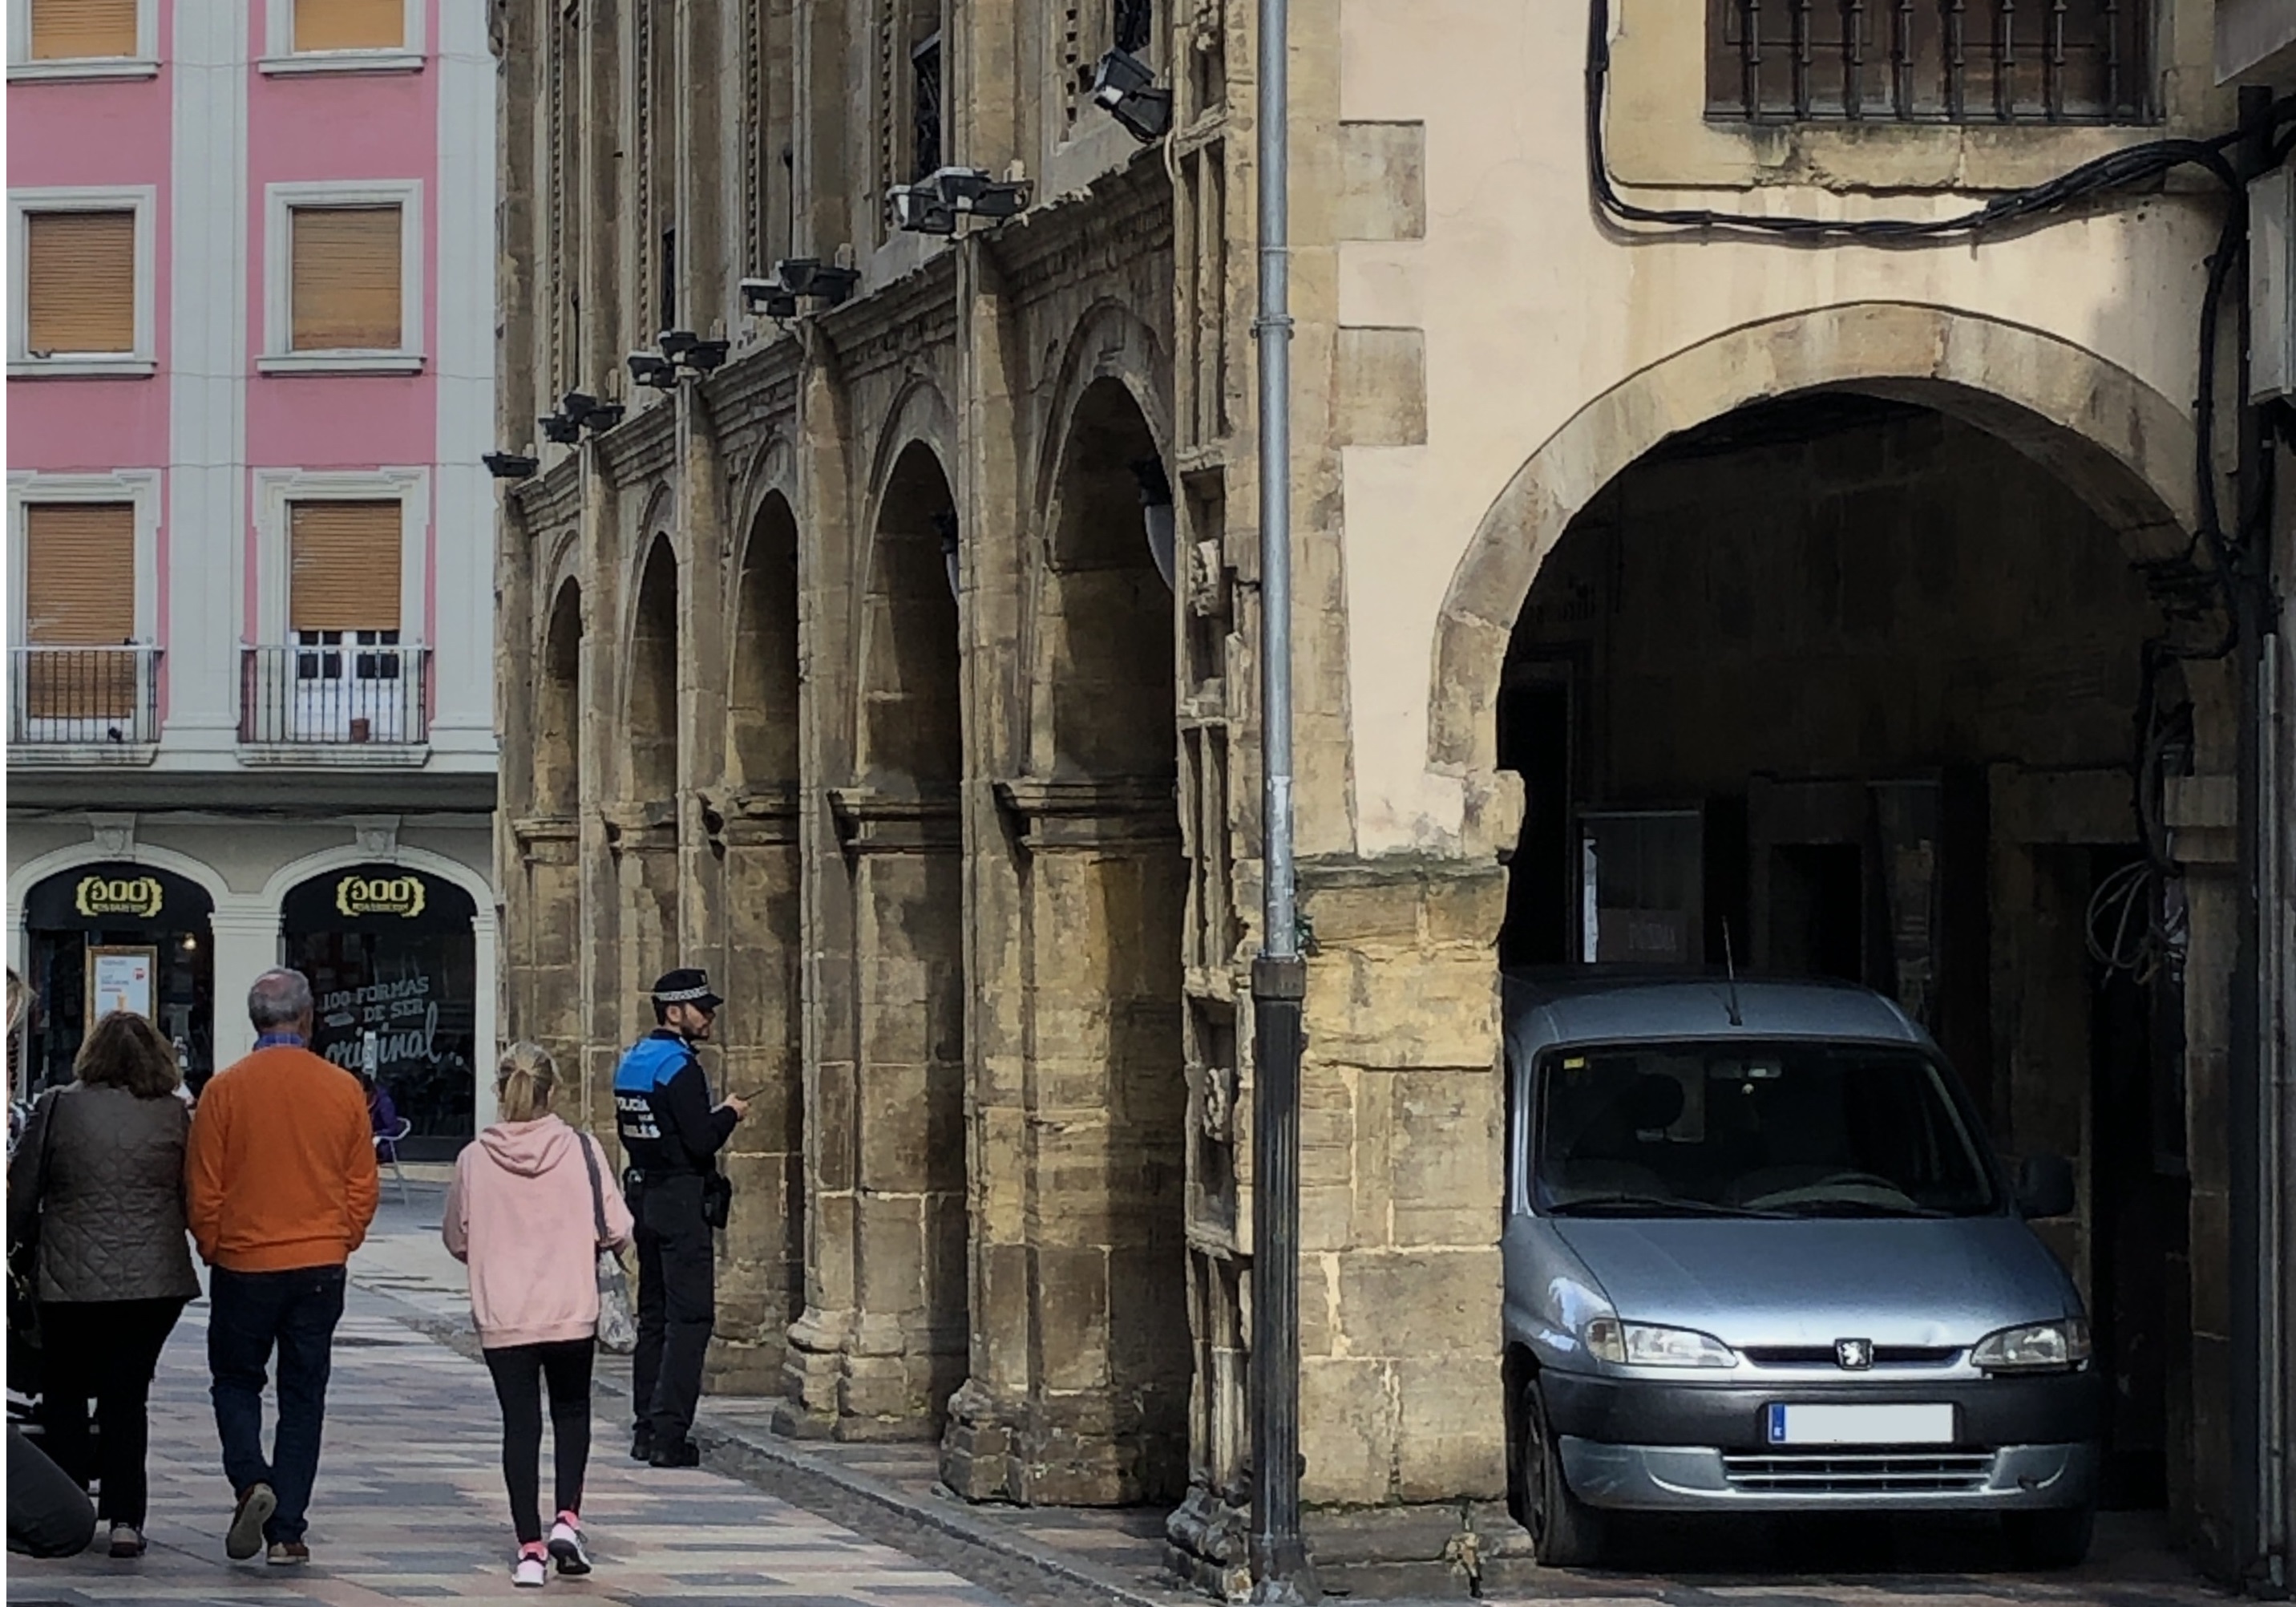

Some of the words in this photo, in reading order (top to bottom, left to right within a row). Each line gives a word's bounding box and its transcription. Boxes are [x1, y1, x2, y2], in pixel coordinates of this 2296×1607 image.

[323, 990, 351, 1012] 100
[355, 976, 430, 1006] FORMAS
[362, 1004, 386, 1023] DE
[390, 998, 426, 1019] SER
